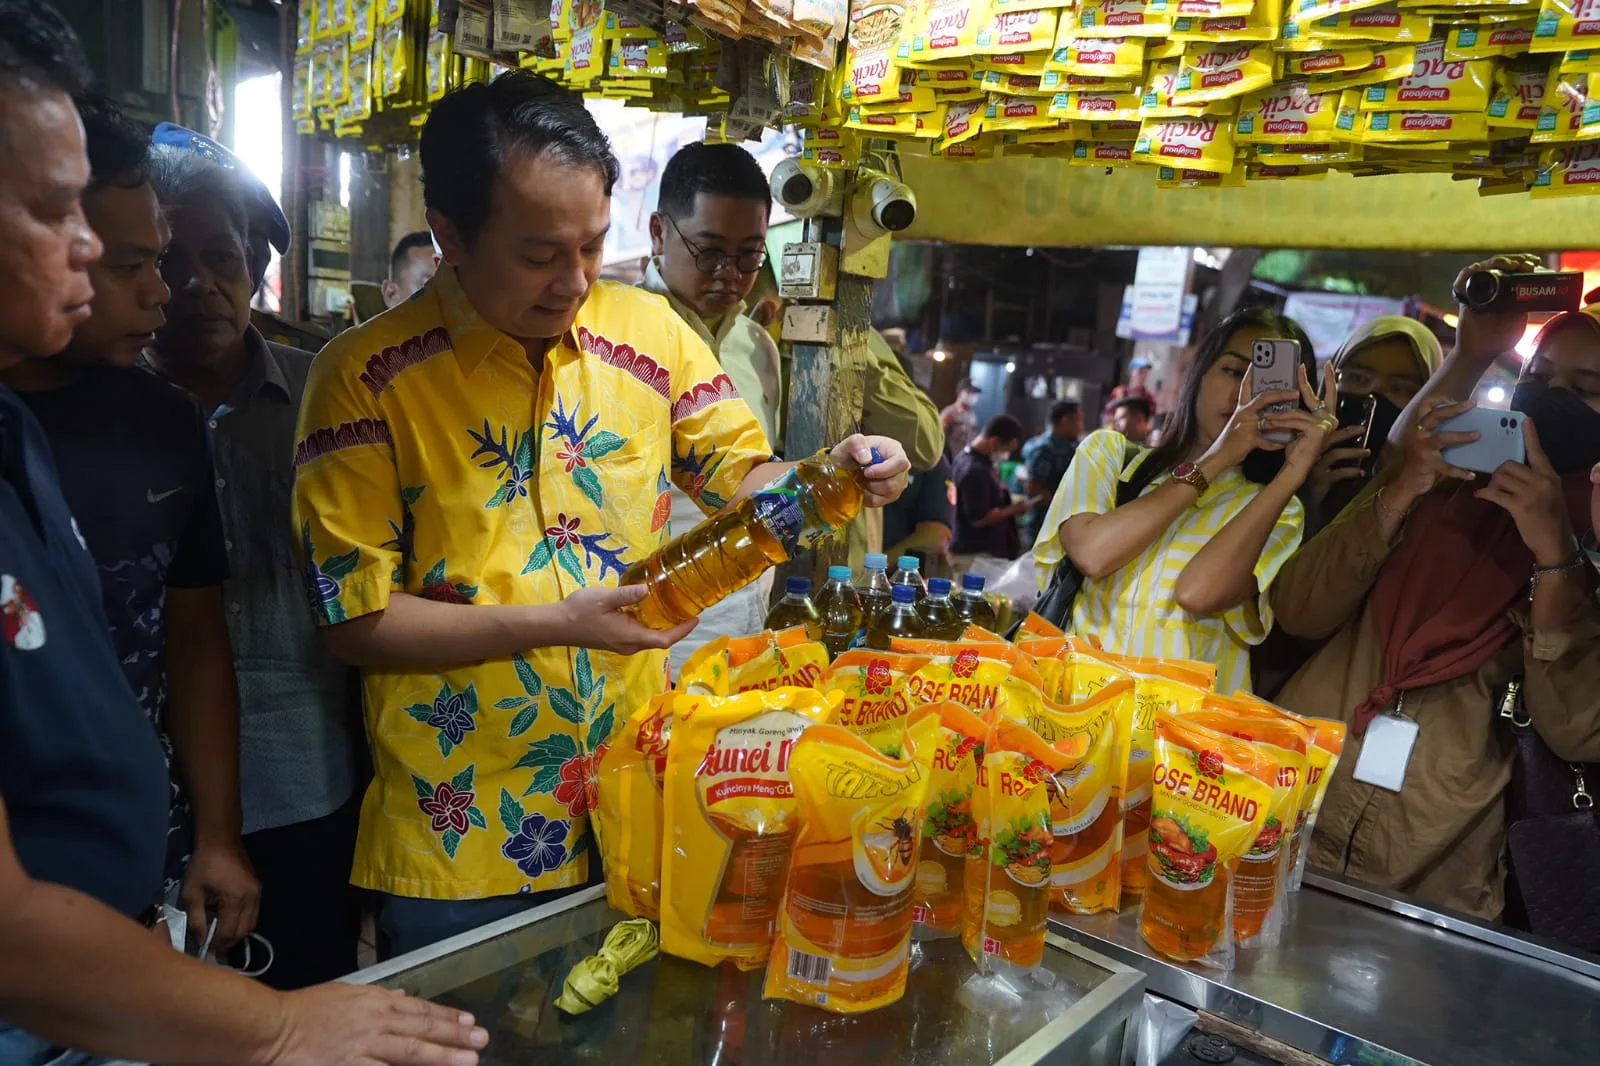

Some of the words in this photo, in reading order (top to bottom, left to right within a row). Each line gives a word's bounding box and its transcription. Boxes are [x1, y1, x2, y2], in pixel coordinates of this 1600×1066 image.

[927, 8, 969, 37] Racik
[1107, 14, 1140, 24] Indofood
[1354, 14, 1396, 24] Indofood
[1079, 52, 1111, 62] Indofood
[852, 59, 889, 86] Racik
[1205, 71, 1238, 84] Indofood
[1401, 90, 1445, 99] Indofood
[1080, 100, 1112, 109] Indofood
[1258, 94, 1322, 119] Racik
[1266, 121, 1303, 132] Indofood
[1404, 118, 1447, 128] Indofood
[1158, 120, 1218, 142] Racik
[1163, 146, 1198, 157] Indofood
[908, 676, 945, 703] OSE
[949, 683, 999, 710] BRAN
[856, 691, 908, 726] BRAND
[728, 727, 756, 736] Minyak
[758, 728, 786, 737] Goreng
[715, 784, 752, 798] Kuncinya
[1153, 763, 1192, 796] OSE
[1192, 780, 1258, 822] BRAND
